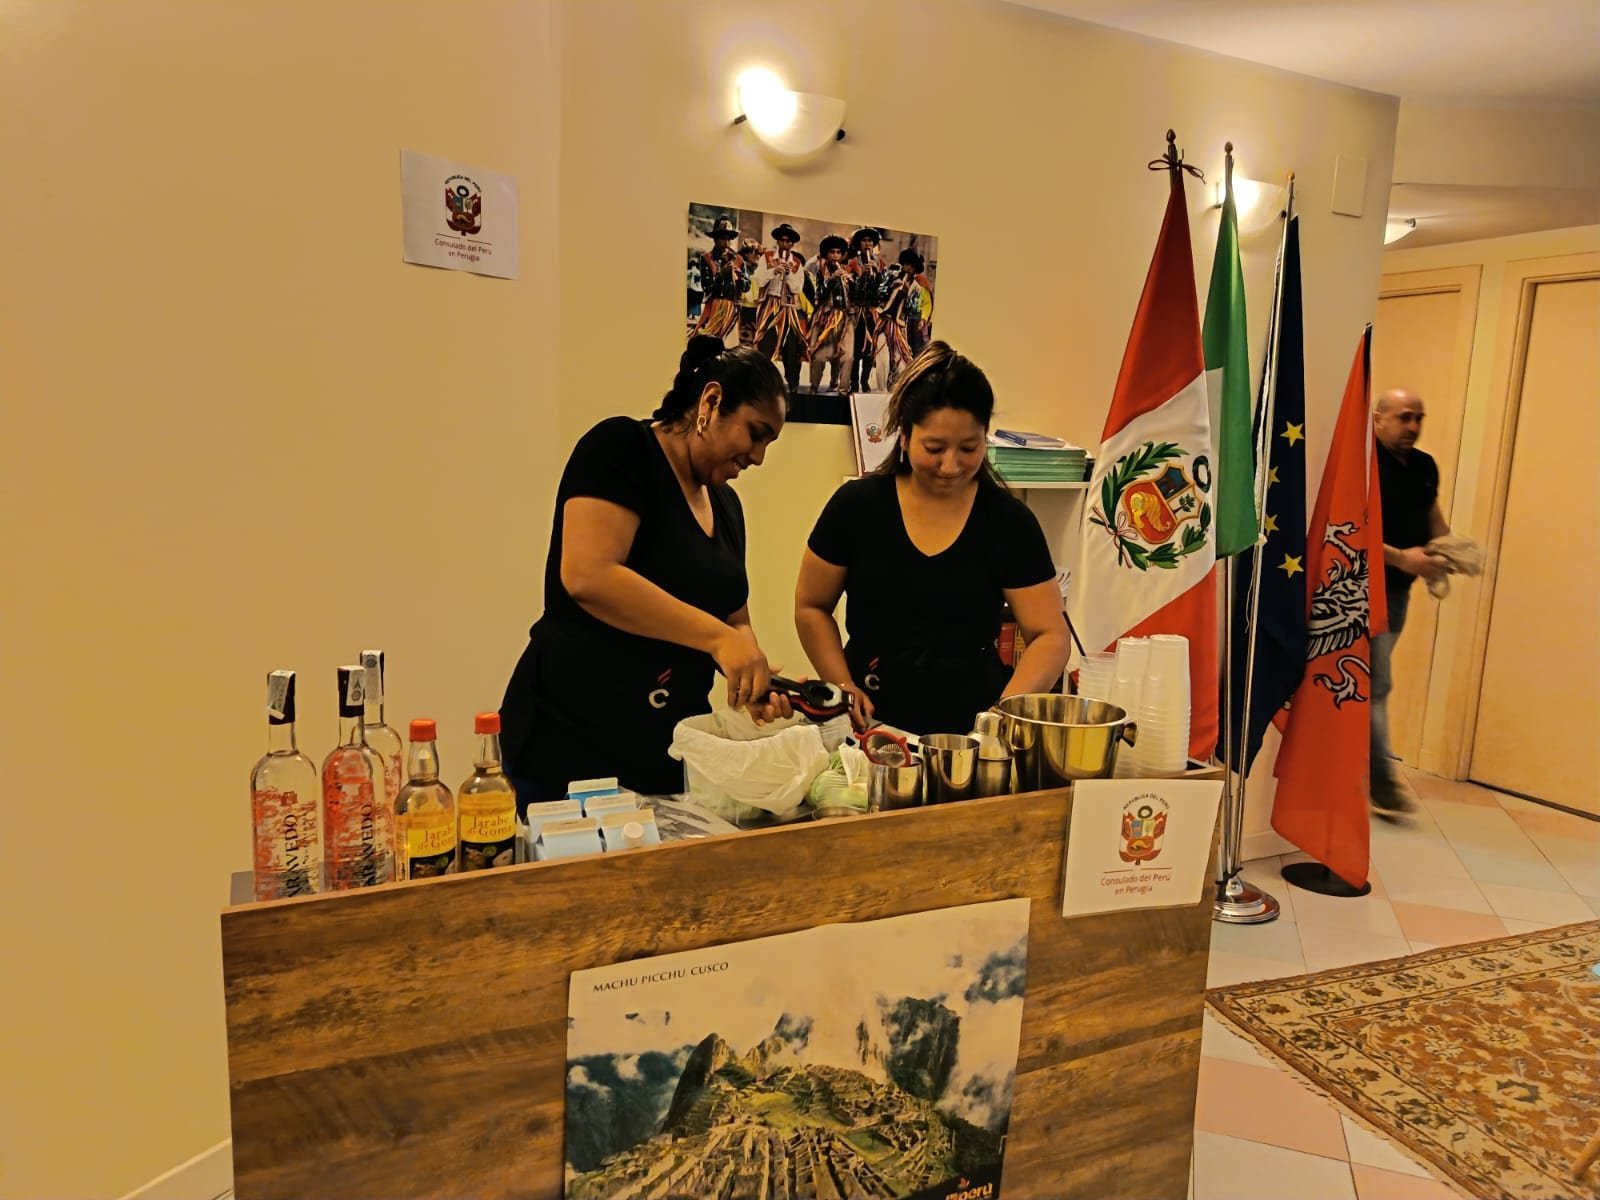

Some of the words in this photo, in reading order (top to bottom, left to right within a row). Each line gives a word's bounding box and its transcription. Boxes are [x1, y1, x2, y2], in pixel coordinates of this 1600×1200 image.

[434, 238, 467, 251] Consulado
[1100, 876, 1138, 887] Consulado
[1139, 873, 1152, 882] del
[1114, 888, 1125, 896] en
[1125, 885, 1153, 895] Perugia
[592, 977, 638, 993] MACHU
[690, 961, 729, 976] CUSCO
